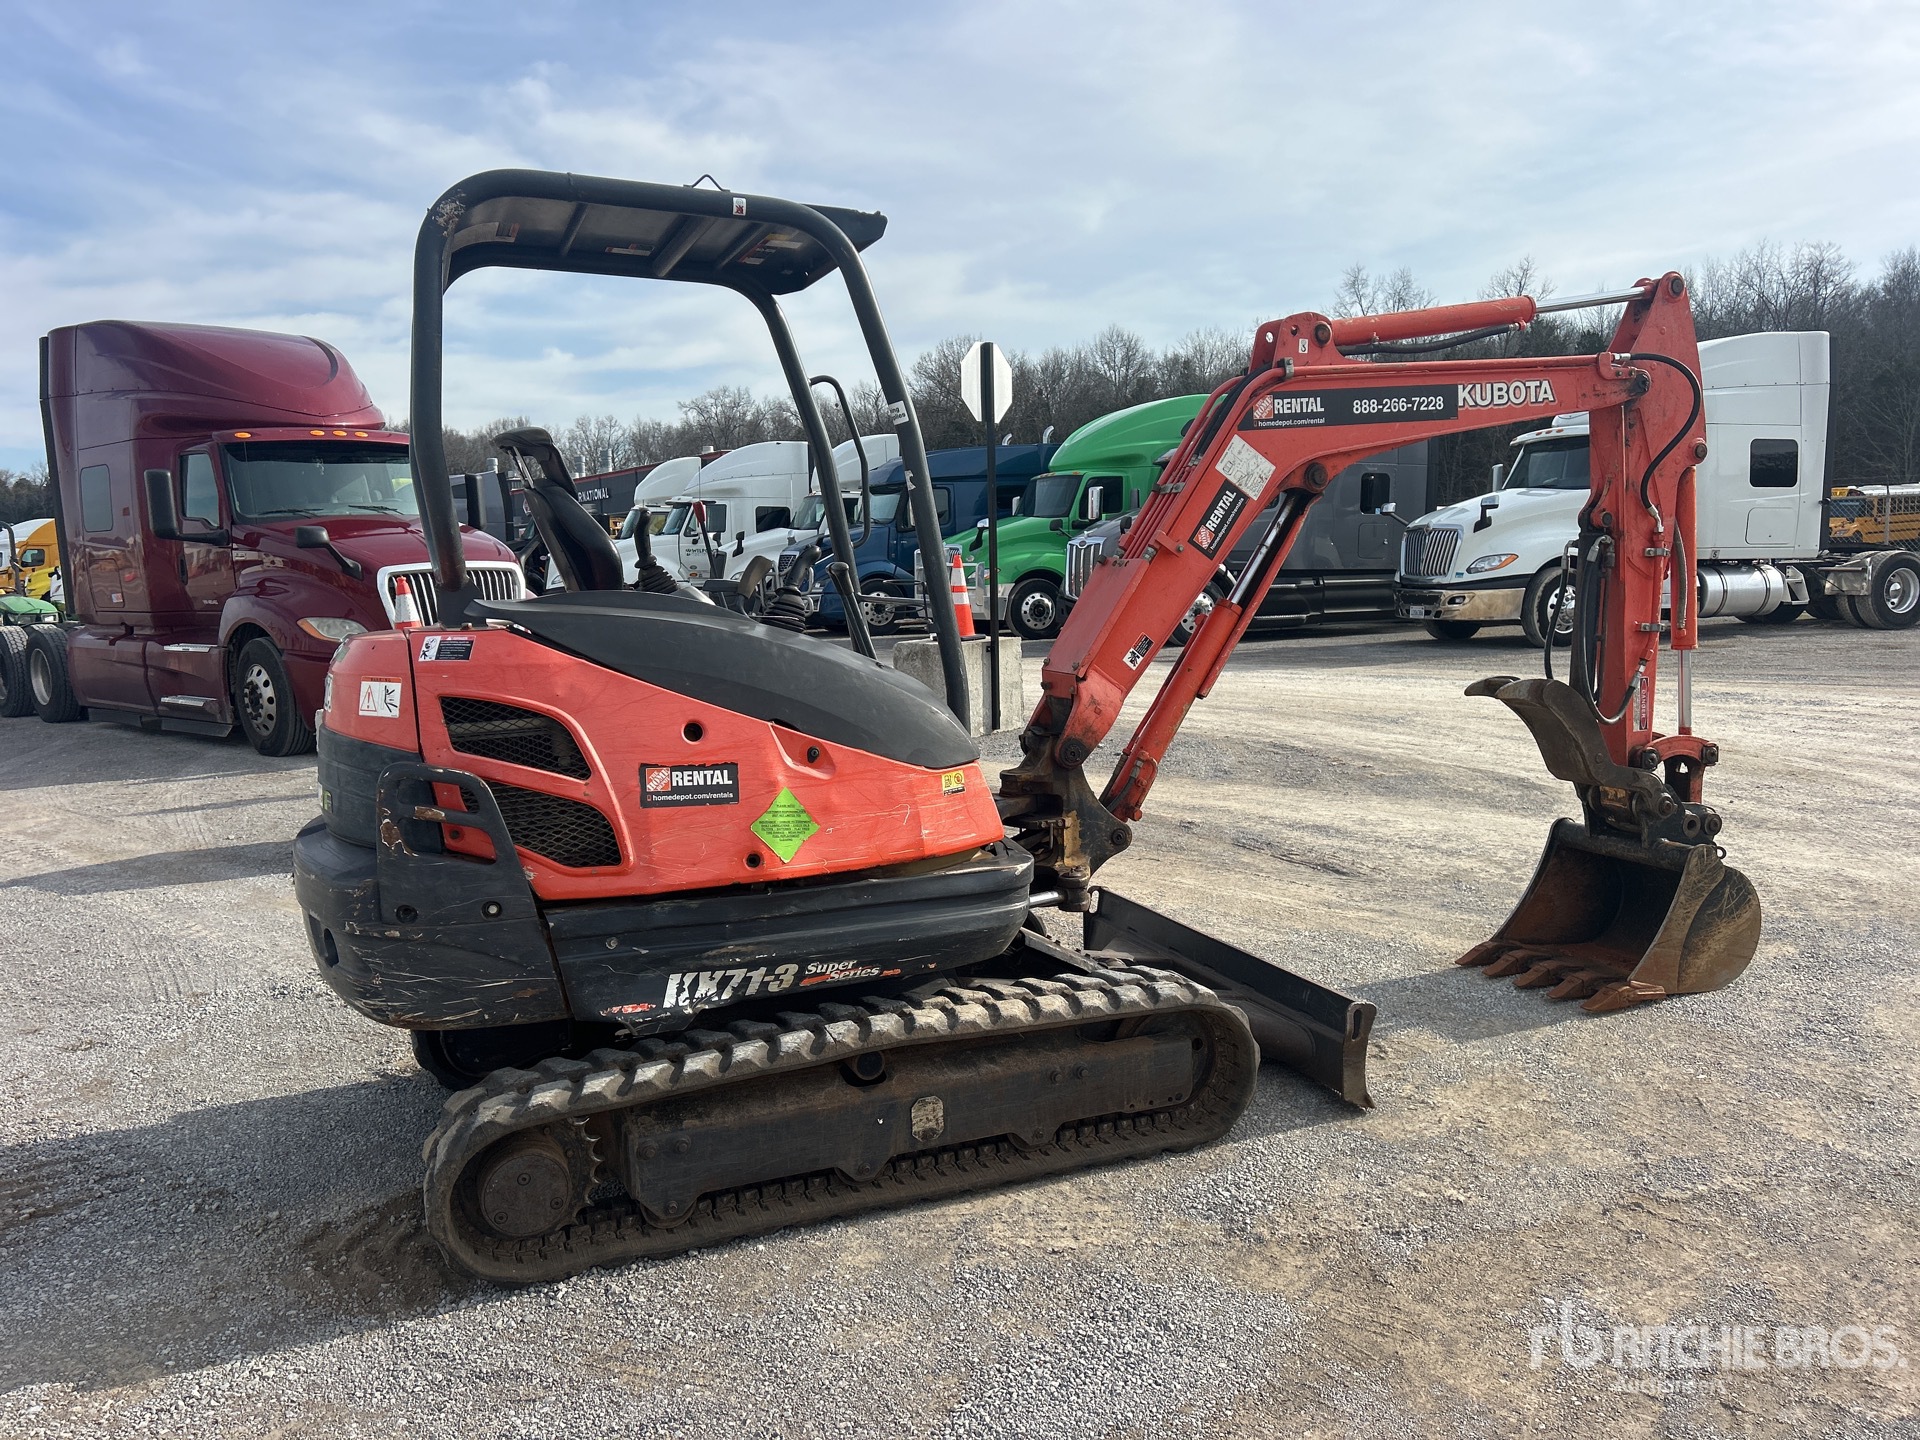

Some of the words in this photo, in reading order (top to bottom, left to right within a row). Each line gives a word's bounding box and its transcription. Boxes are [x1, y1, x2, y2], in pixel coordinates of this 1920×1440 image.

[1458, 380, 1554, 407] KUBOTA
[1254, 395, 1273, 419] HOME
[1274, 397, 1325, 414] RENTAL
[1352, 396, 1444, 414] 888-266-7228
[1258, 417, 1325, 427] homedepot.com/rental
[1205, 490, 1237, 532] RENTAL
[1210, 497, 1245, 550] homedepot.com/rentals
[646, 768, 670, 791] HOME
[648, 770, 660, 780] THE
[671, 770, 733, 787] RENTAL
[655, 777, 670, 791] DEPOT
[652, 792, 734, 802] homedepot.com/rentals
[805, 960, 858, 975] Super
[827, 967, 880, 981] Series
[662, 963, 799, 1008] KX71-3
